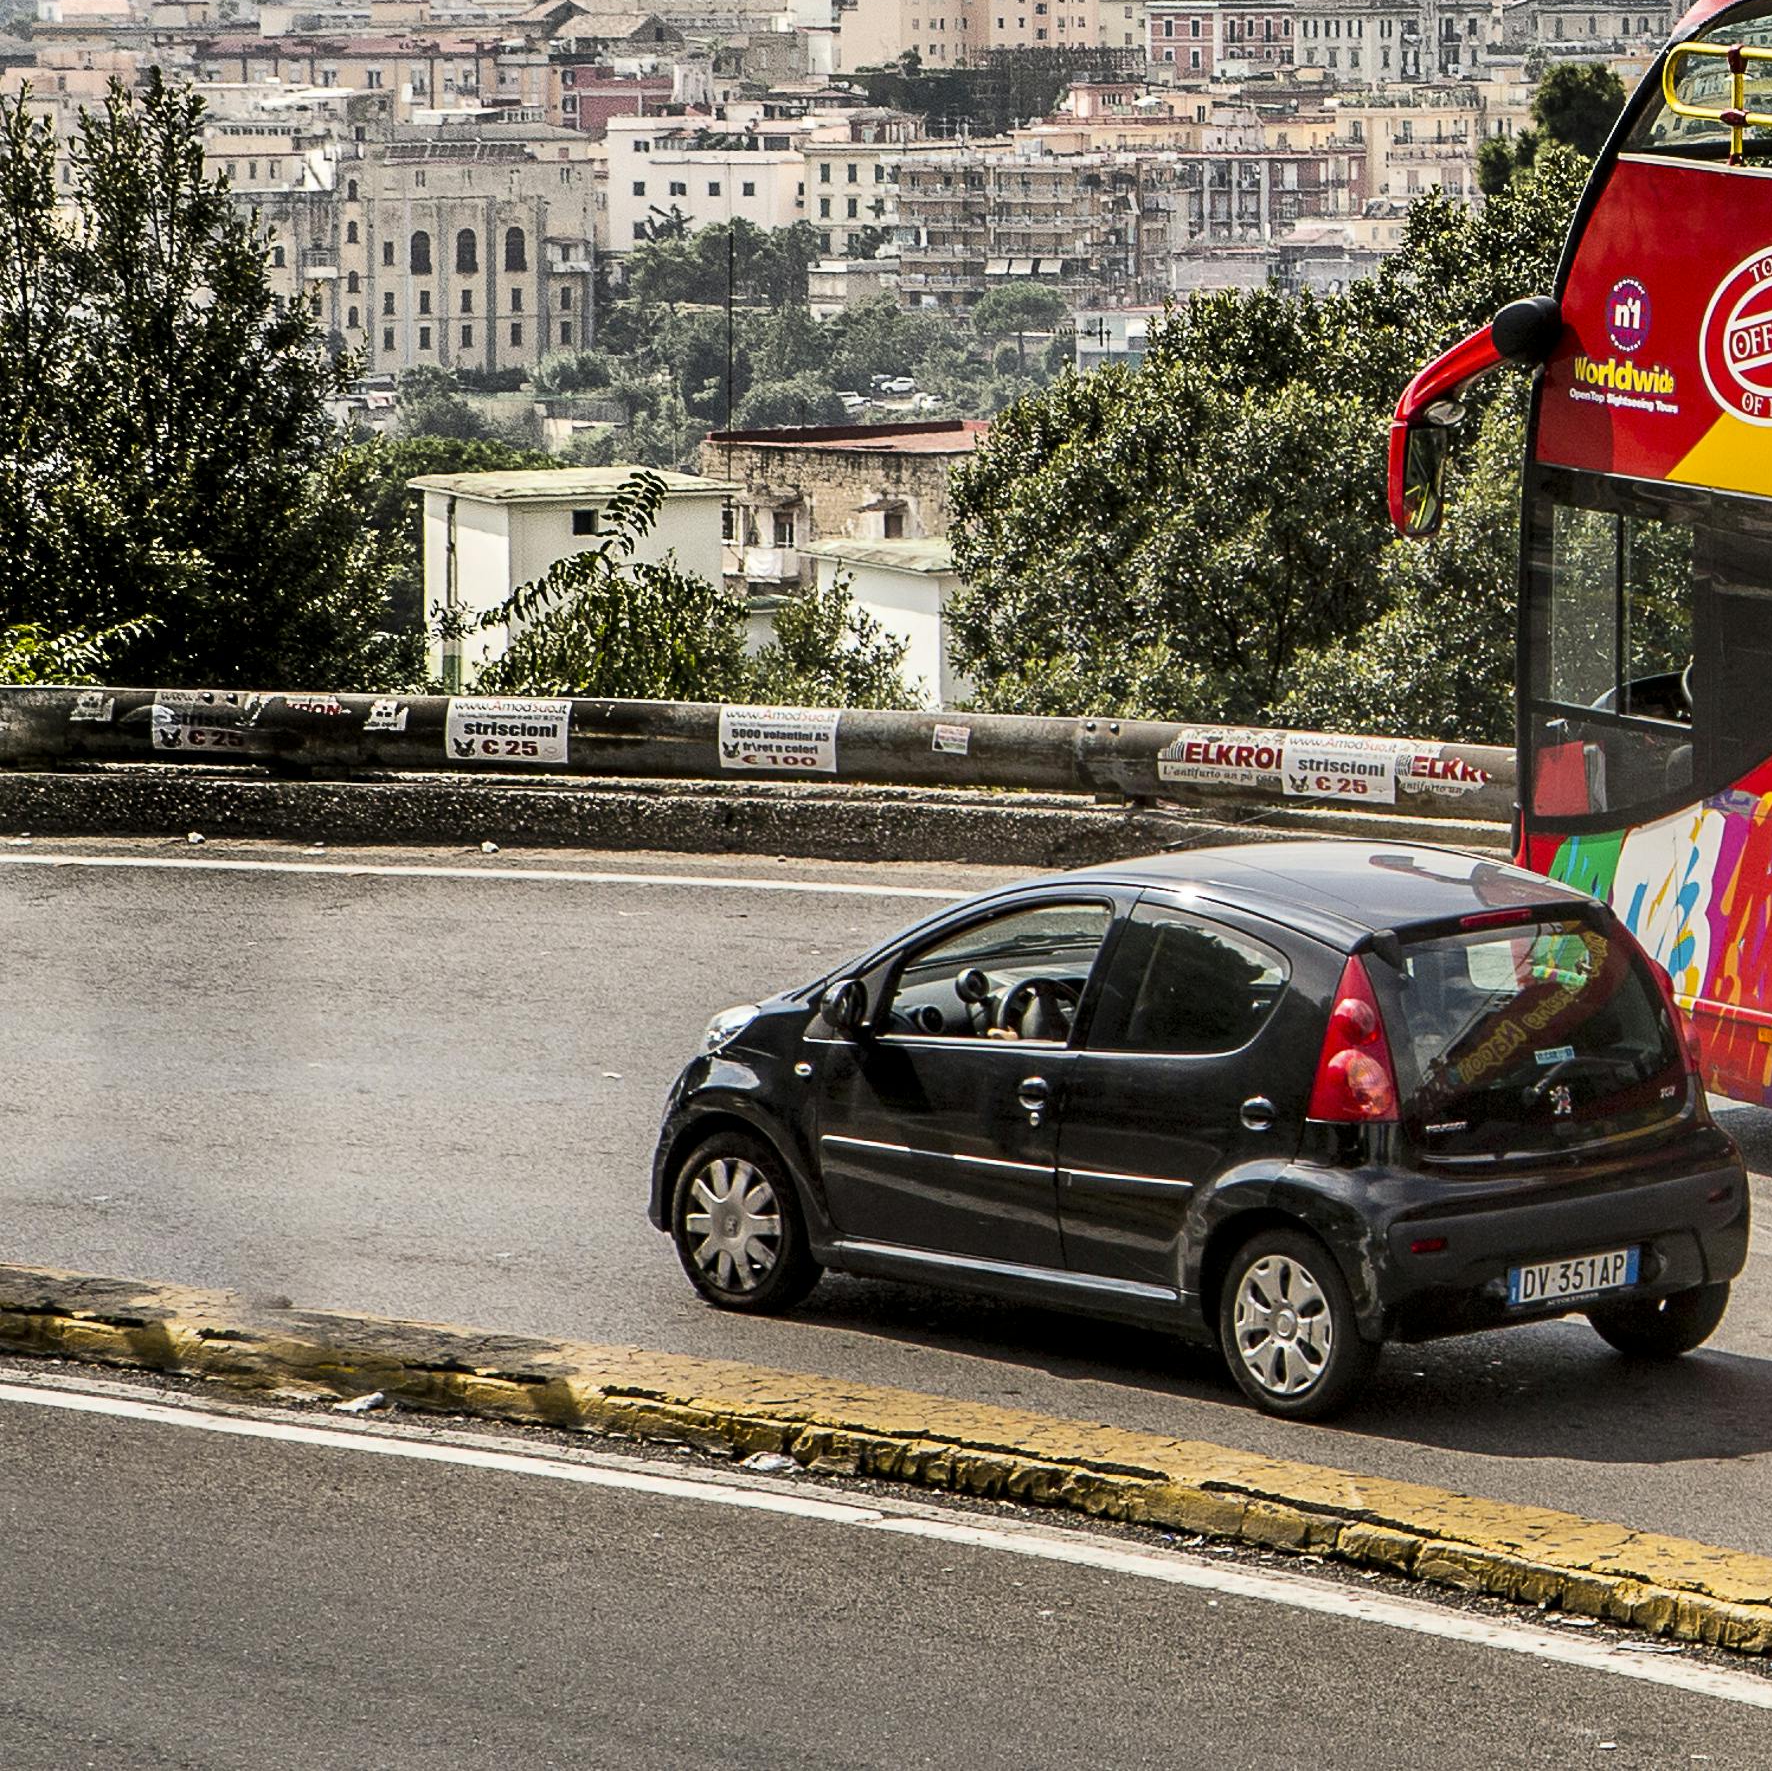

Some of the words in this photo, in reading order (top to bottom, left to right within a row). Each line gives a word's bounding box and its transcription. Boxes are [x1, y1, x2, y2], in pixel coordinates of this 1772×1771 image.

[1574, 356, 1675, 394] Worldwide
[1741, 391, 1763, 416] OF
[463, 721, 558, 738] striscioni
[731, 728, 761, 740] 5000
[763, 730, 813, 742] volantini
[211, 731, 245, 747] 25
[481, 739, 500, 755] €
[506, 740, 539, 757] 25
[785, 743, 819, 755] colori
[741, 754, 759, 765] €
[766, 755, 817, 767] 100
[1298, 758, 1385, 777] striscioni
[1315, 775, 1332, 791] €
[1337, 778, 1368, 794] 25
[1523, 1266, 1550, 1299] DV
[1558, 1254, 1625, 1293] 351AP
